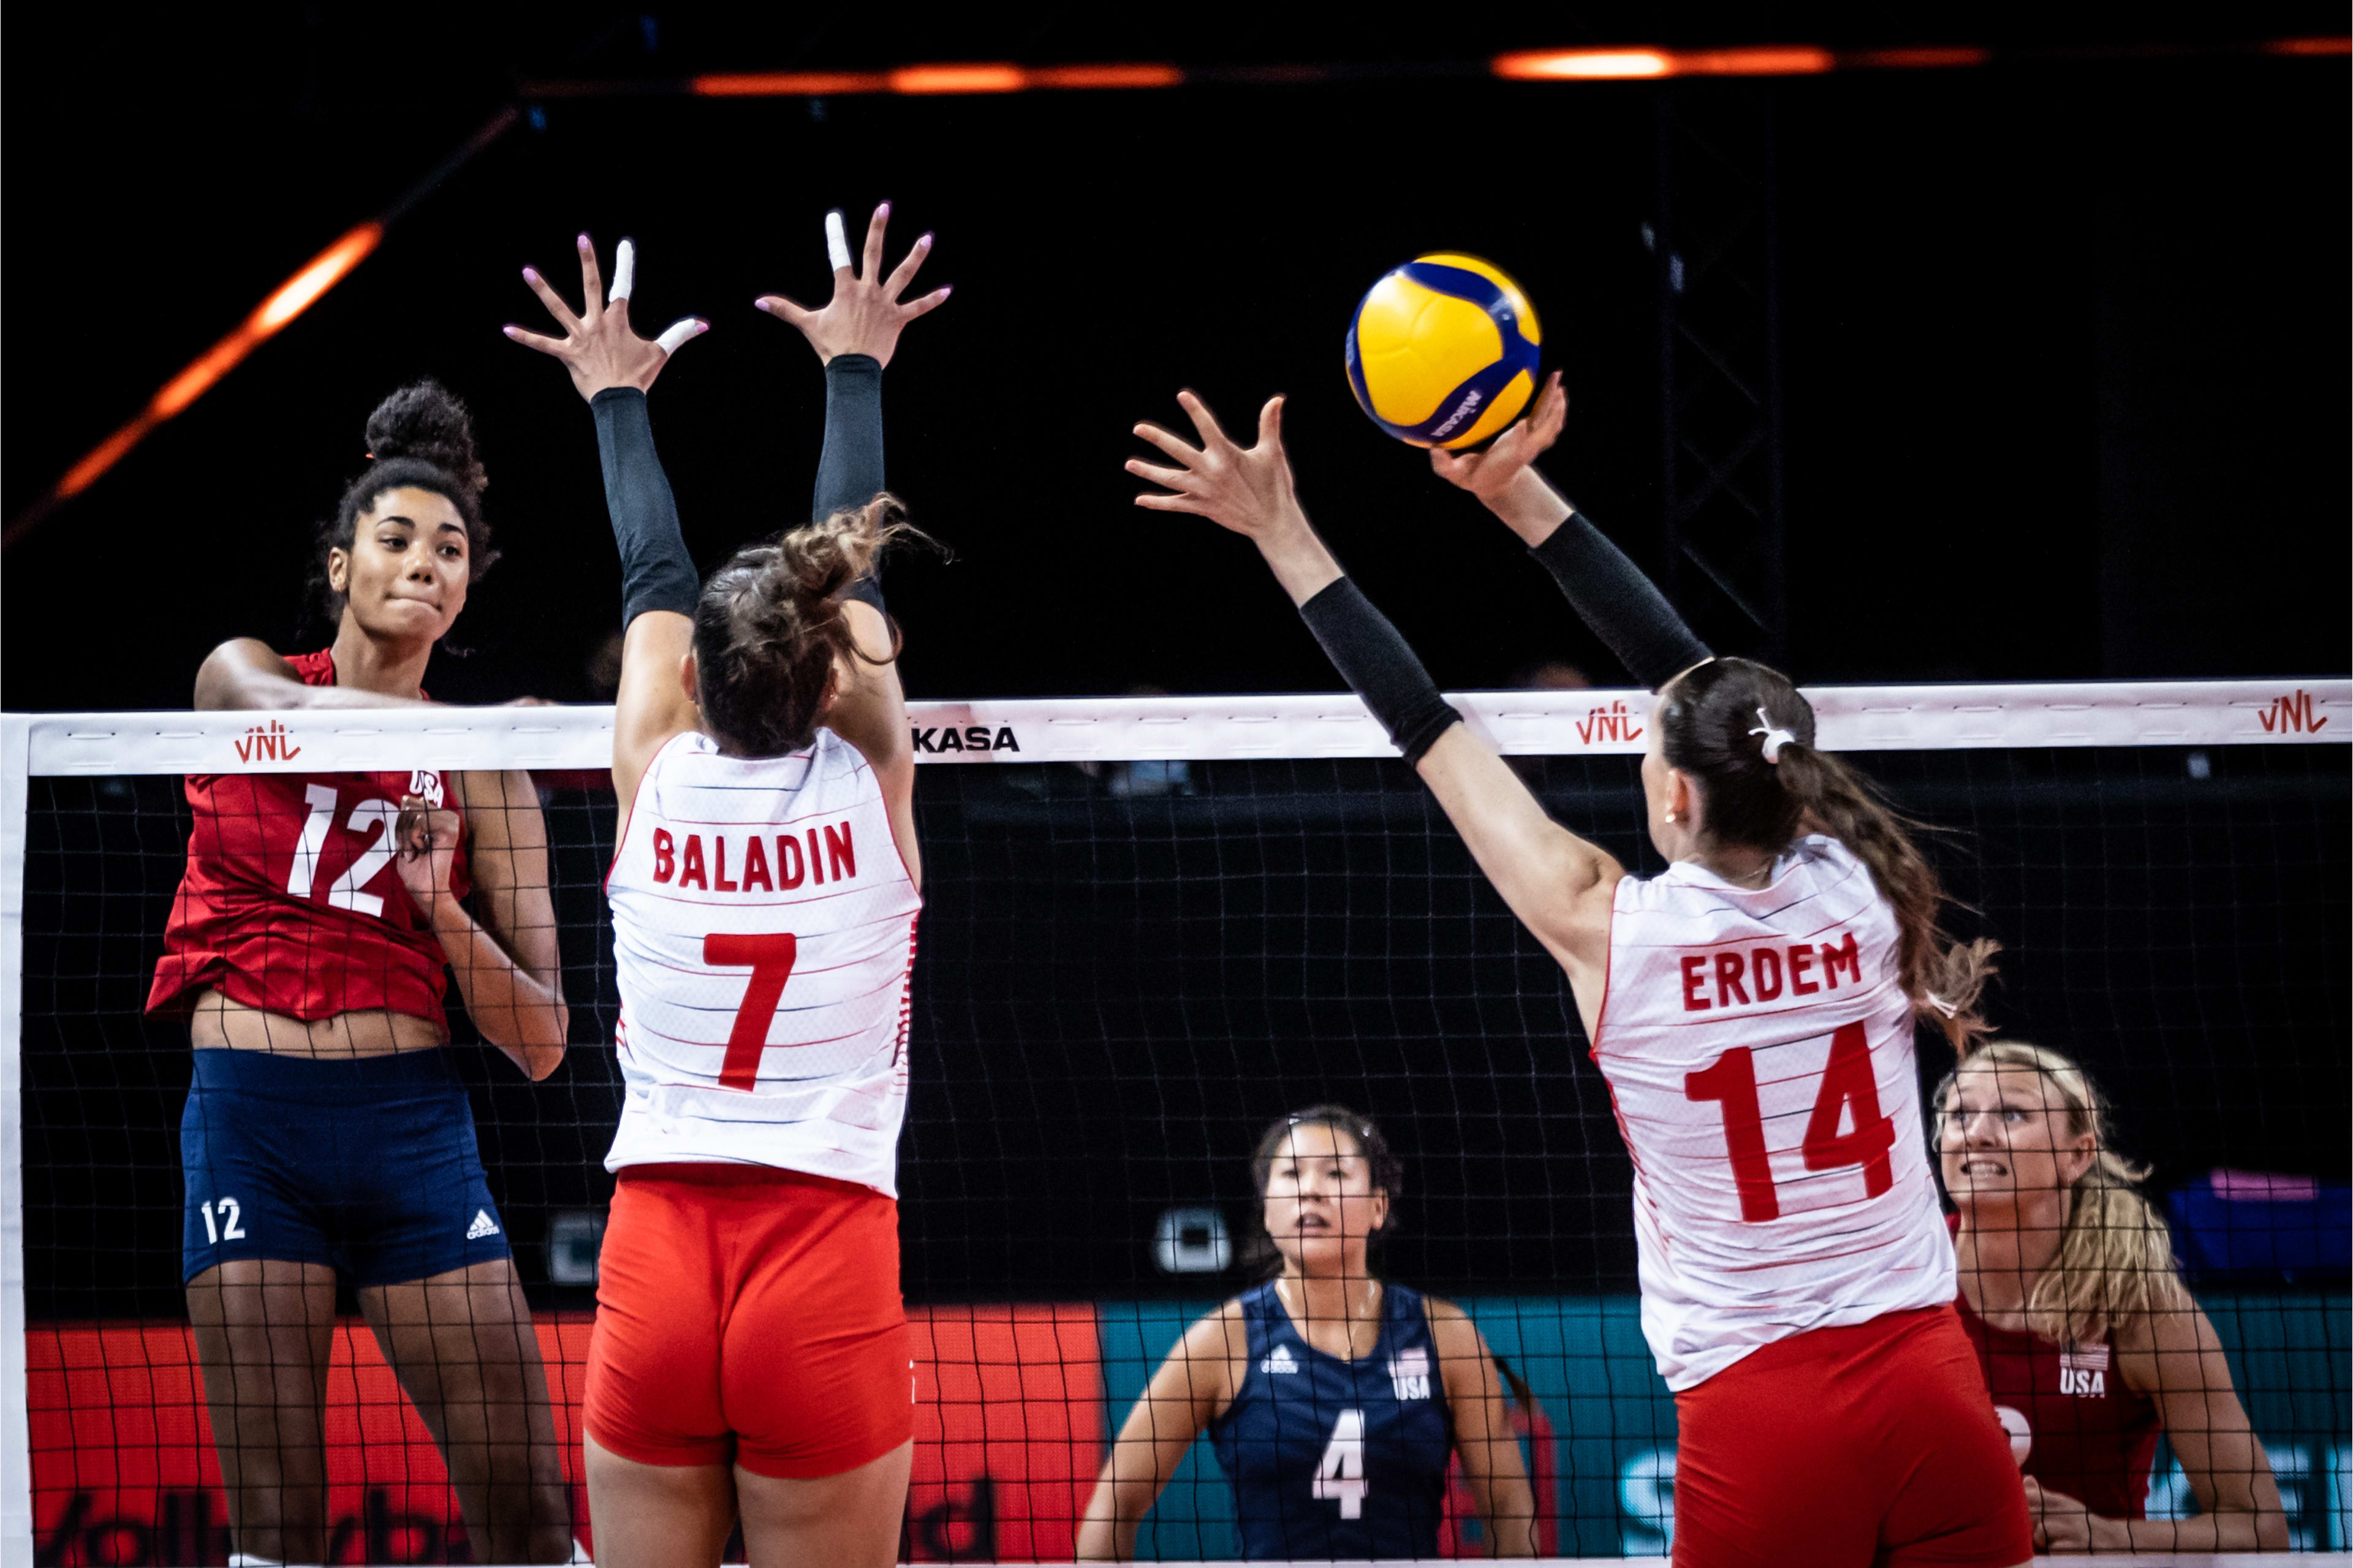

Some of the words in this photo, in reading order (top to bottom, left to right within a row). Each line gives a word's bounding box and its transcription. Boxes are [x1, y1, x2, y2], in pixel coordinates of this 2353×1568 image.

[1575, 699, 1643, 744] VNL
[2258, 689, 2327, 733] VNL
[235, 719, 300, 763] VNL
[287, 783, 401, 917] 12
[653, 821, 857, 892] BALADIN
[1681, 932, 1861, 1011] ERDEM
[703, 933, 797, 1092] 7
[1684, 1020, 1895, 1223] 14
[201, 1197, 245, 1244] 12
[1392, 1376, 1430, 1400] USA
[2059, 1367, 2106, 1398] USA
[1313, 1409, 1368, 1520] 4
